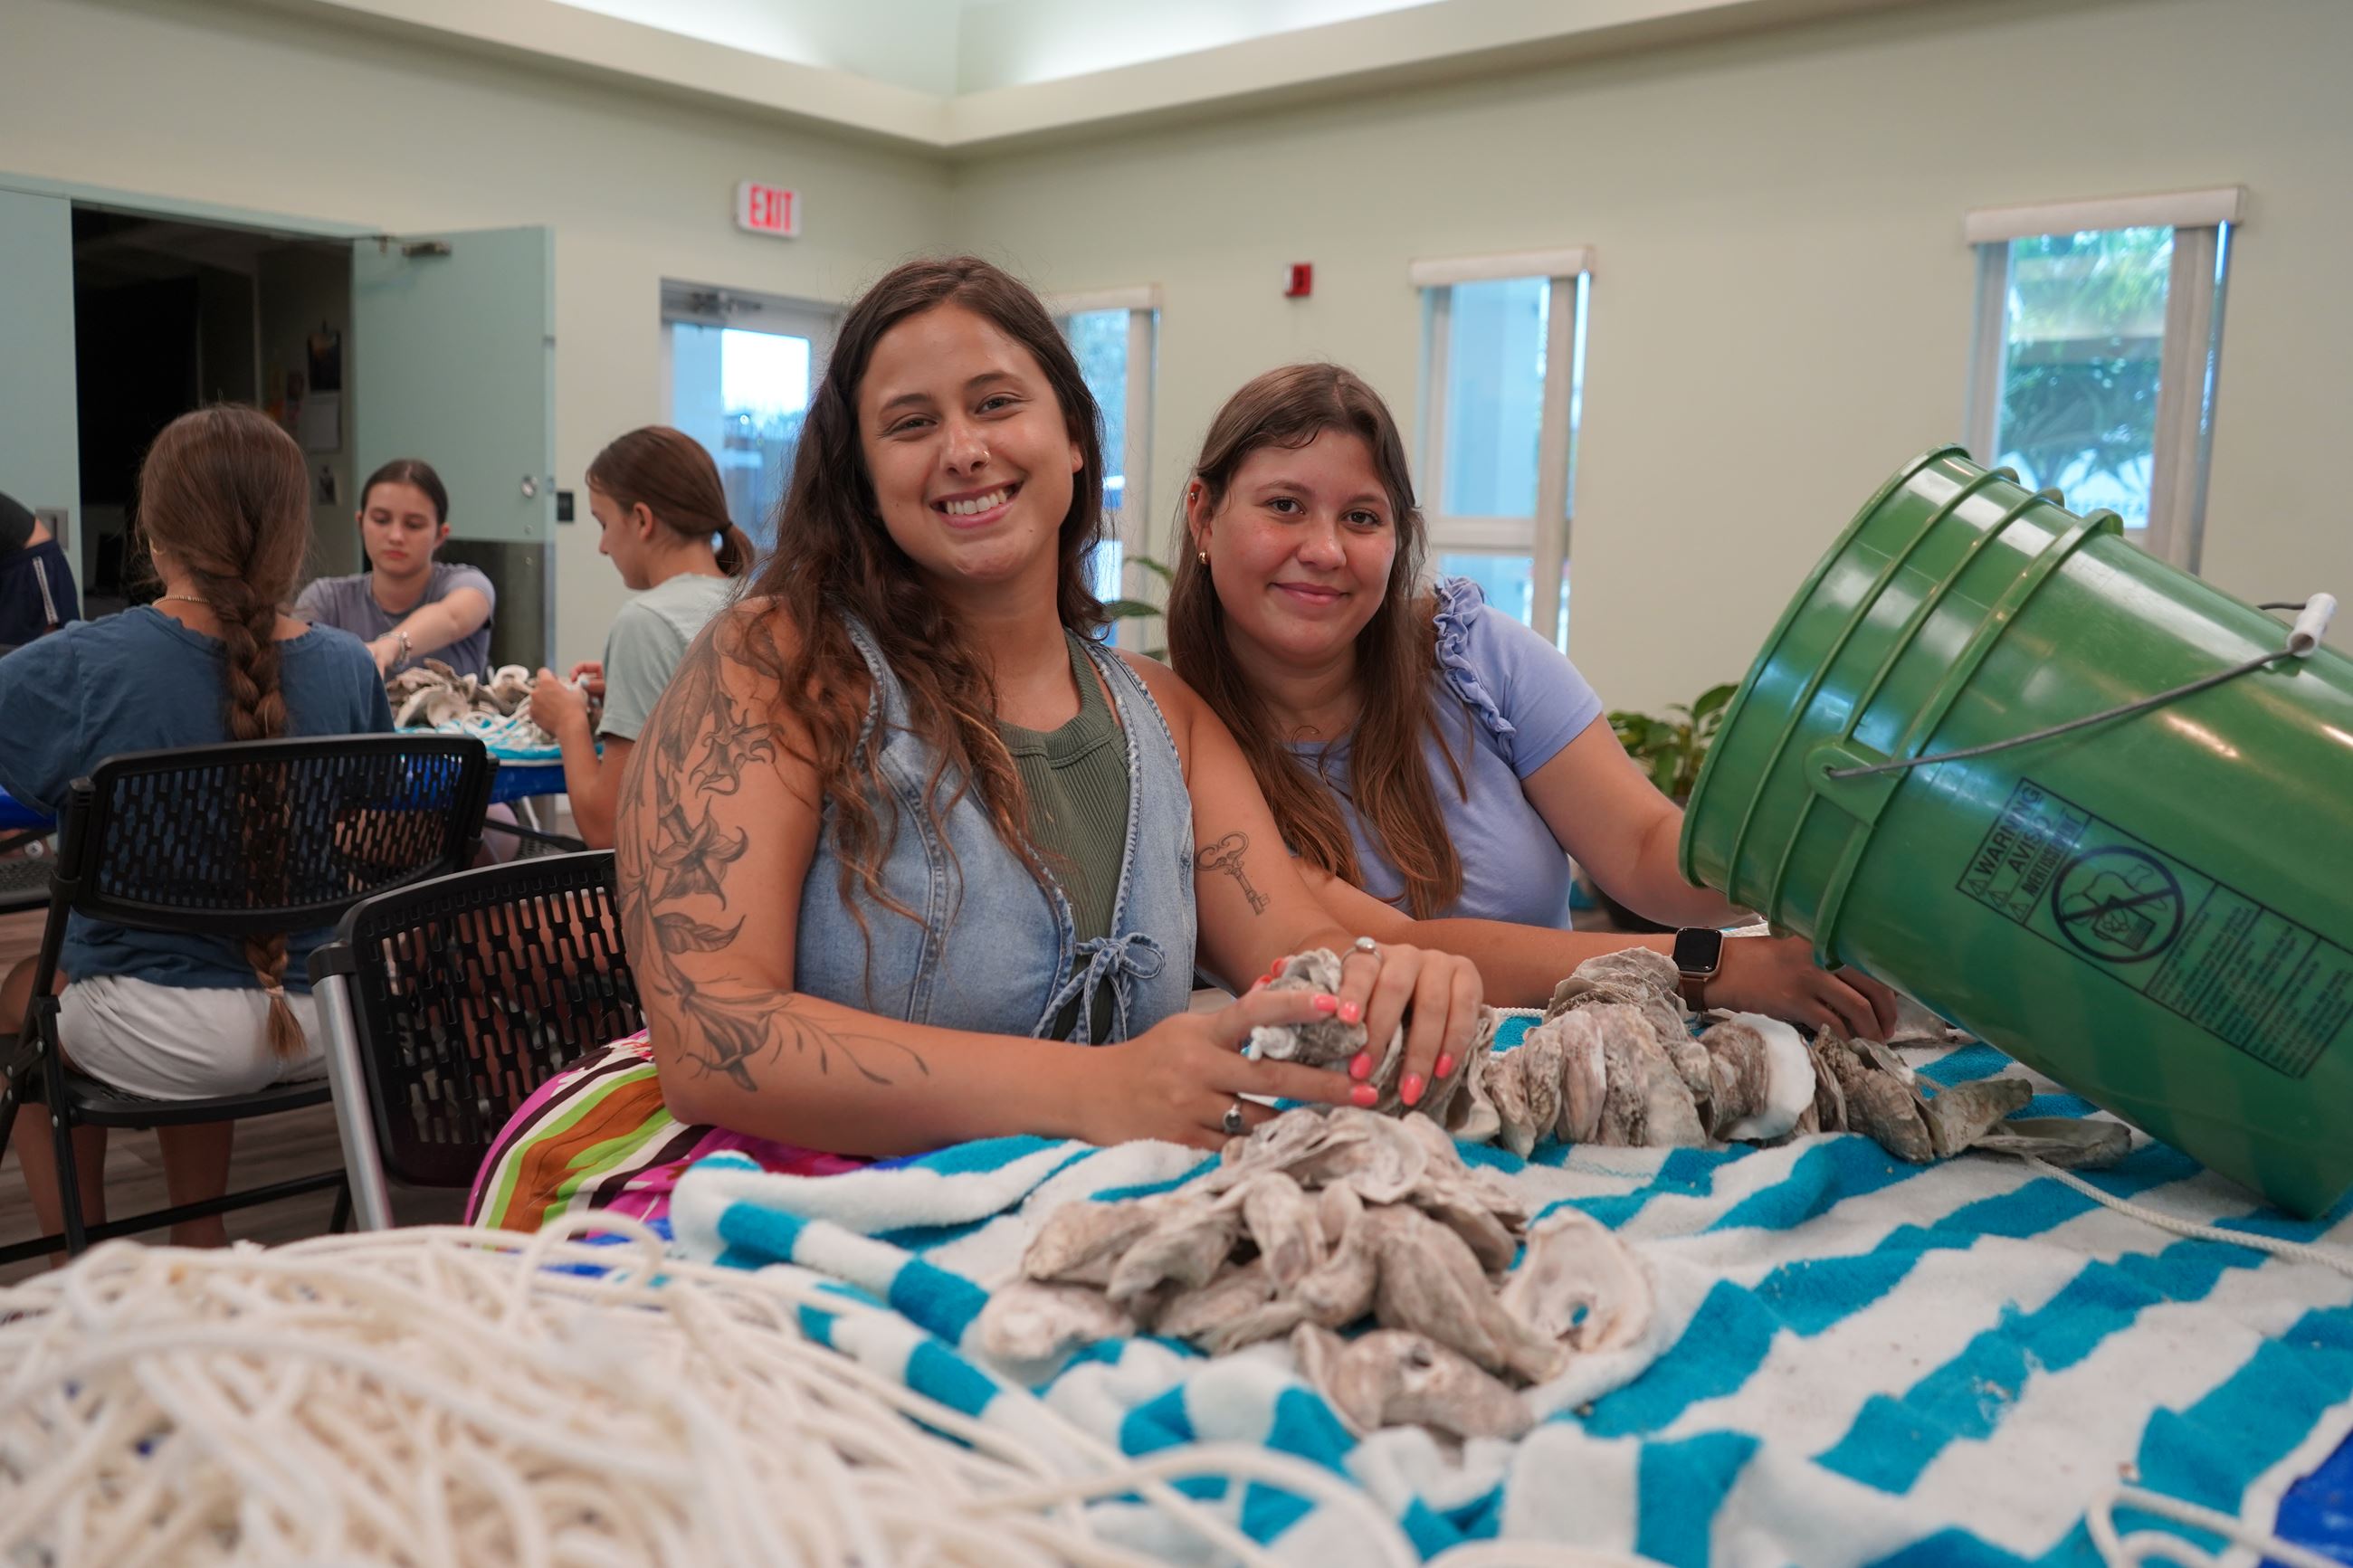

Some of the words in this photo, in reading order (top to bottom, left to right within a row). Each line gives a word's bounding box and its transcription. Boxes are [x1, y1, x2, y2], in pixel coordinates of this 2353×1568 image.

[749, 185, 793, 233] EXIT
[1974, 786, 2043, 875] WARNING
[2007, 816, 2051, 875] AVISO
